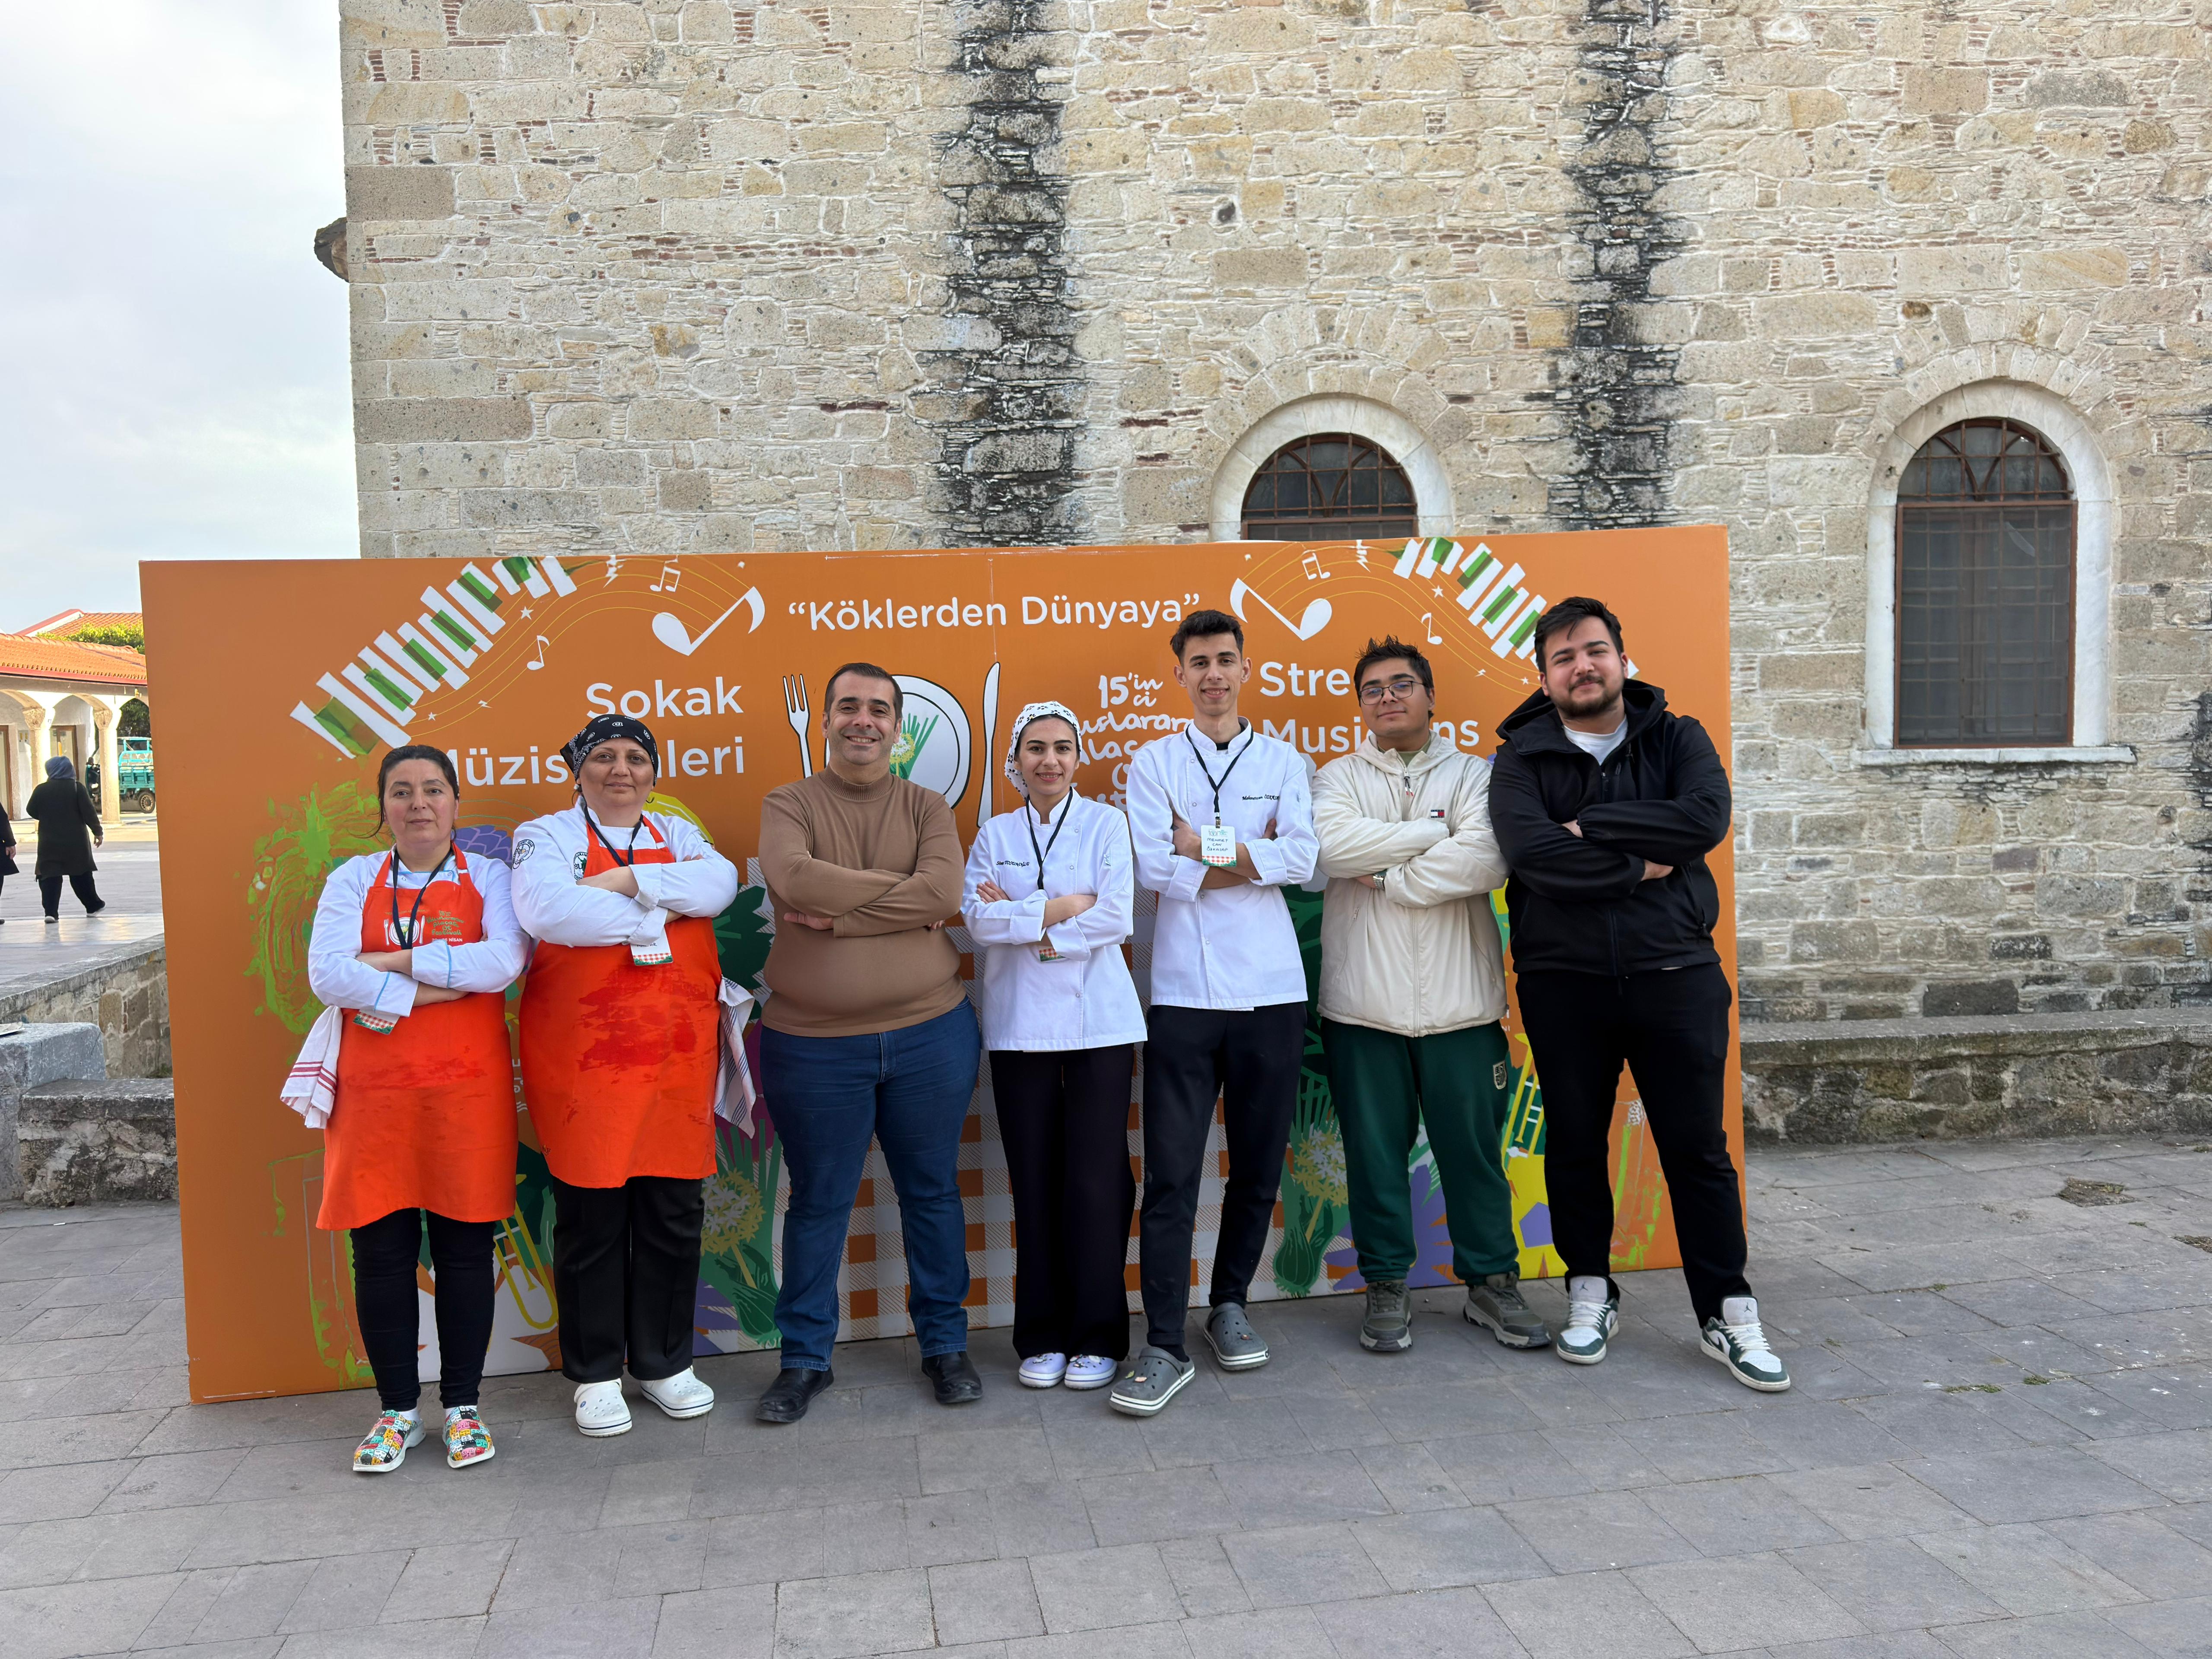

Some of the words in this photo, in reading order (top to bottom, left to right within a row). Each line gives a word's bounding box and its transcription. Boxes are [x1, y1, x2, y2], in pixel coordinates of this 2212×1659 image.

[788, 596, 1007, 631] “Köklerden
[1021, 593, 1200, 630] Dünyaya”
[586, 676, 744, 719] Sokak
[1259, 661, 1355, 697] Stre
[1262, 716, 1480, 753] Musins
[444, 736, 744, 787] üzisleri
